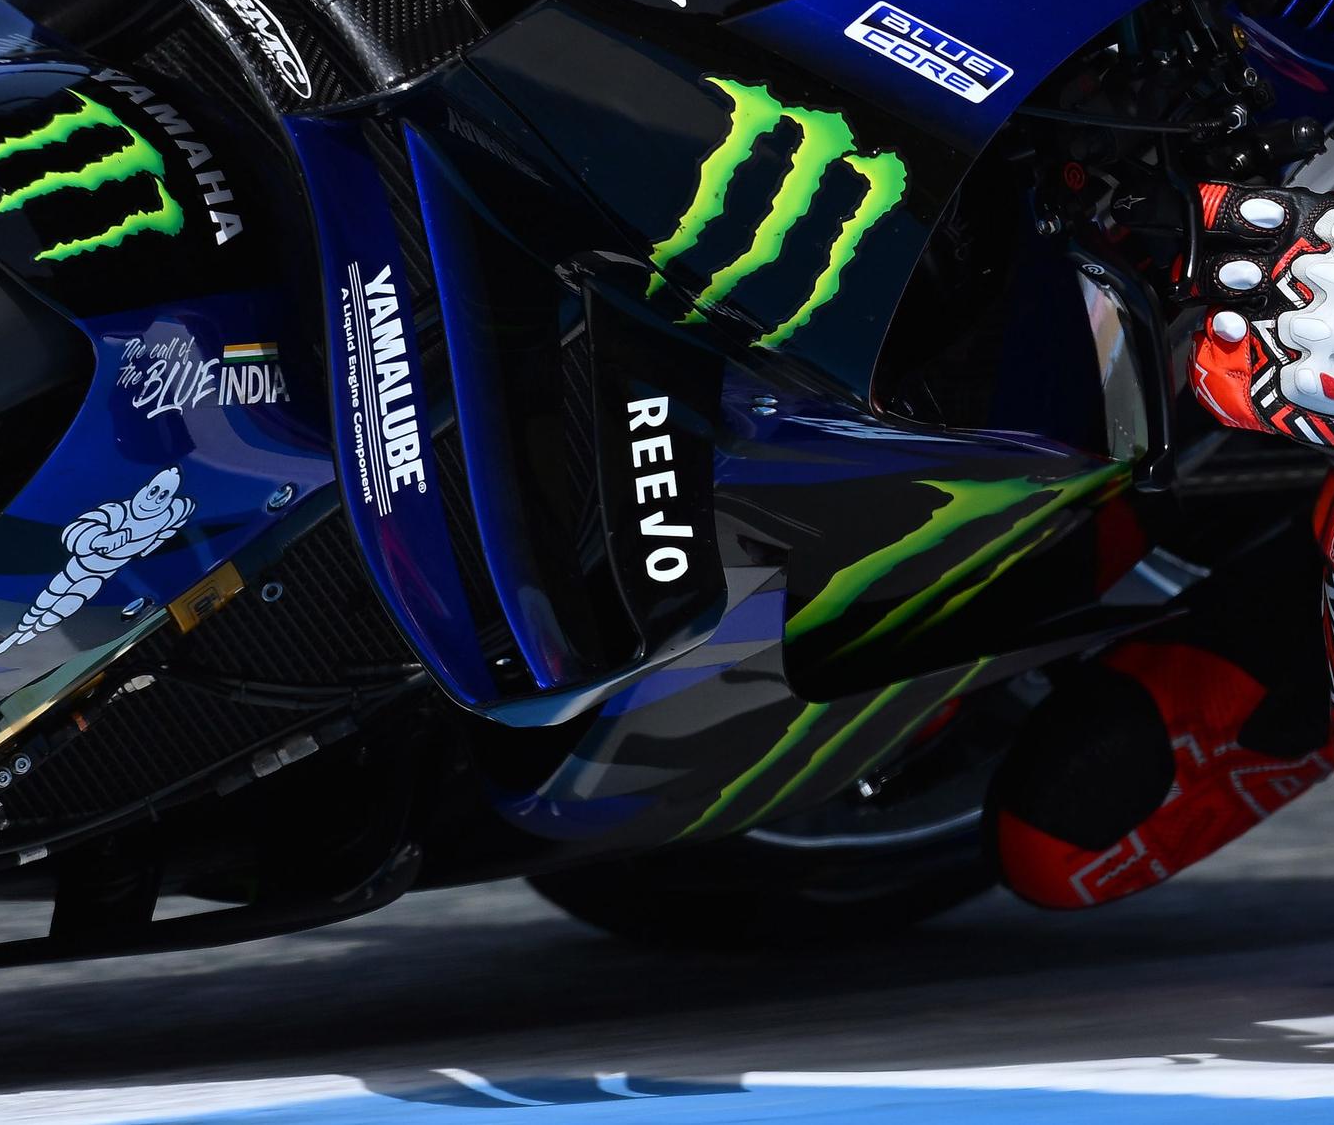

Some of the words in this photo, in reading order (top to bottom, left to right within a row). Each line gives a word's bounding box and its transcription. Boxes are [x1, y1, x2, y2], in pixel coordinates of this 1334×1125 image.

[863, 29, 975, 92] CORE
[881, 11, 995, 77] BLUE
[90, 67, 244, 246] YAMAHA
[341, 287, 350, 301] A
[149, 336, 179, 360] call
[178, 336, 196, 365] of
[343, 303, 356, 352] Liquid
[132, 358, 220, 419] BLUE
[218, 364, 291, 406] INDIA
[348, 354, 360, 408] Engine
[353, 411, 373, 504] Component
[627, 395, 693, 583] REEVO
